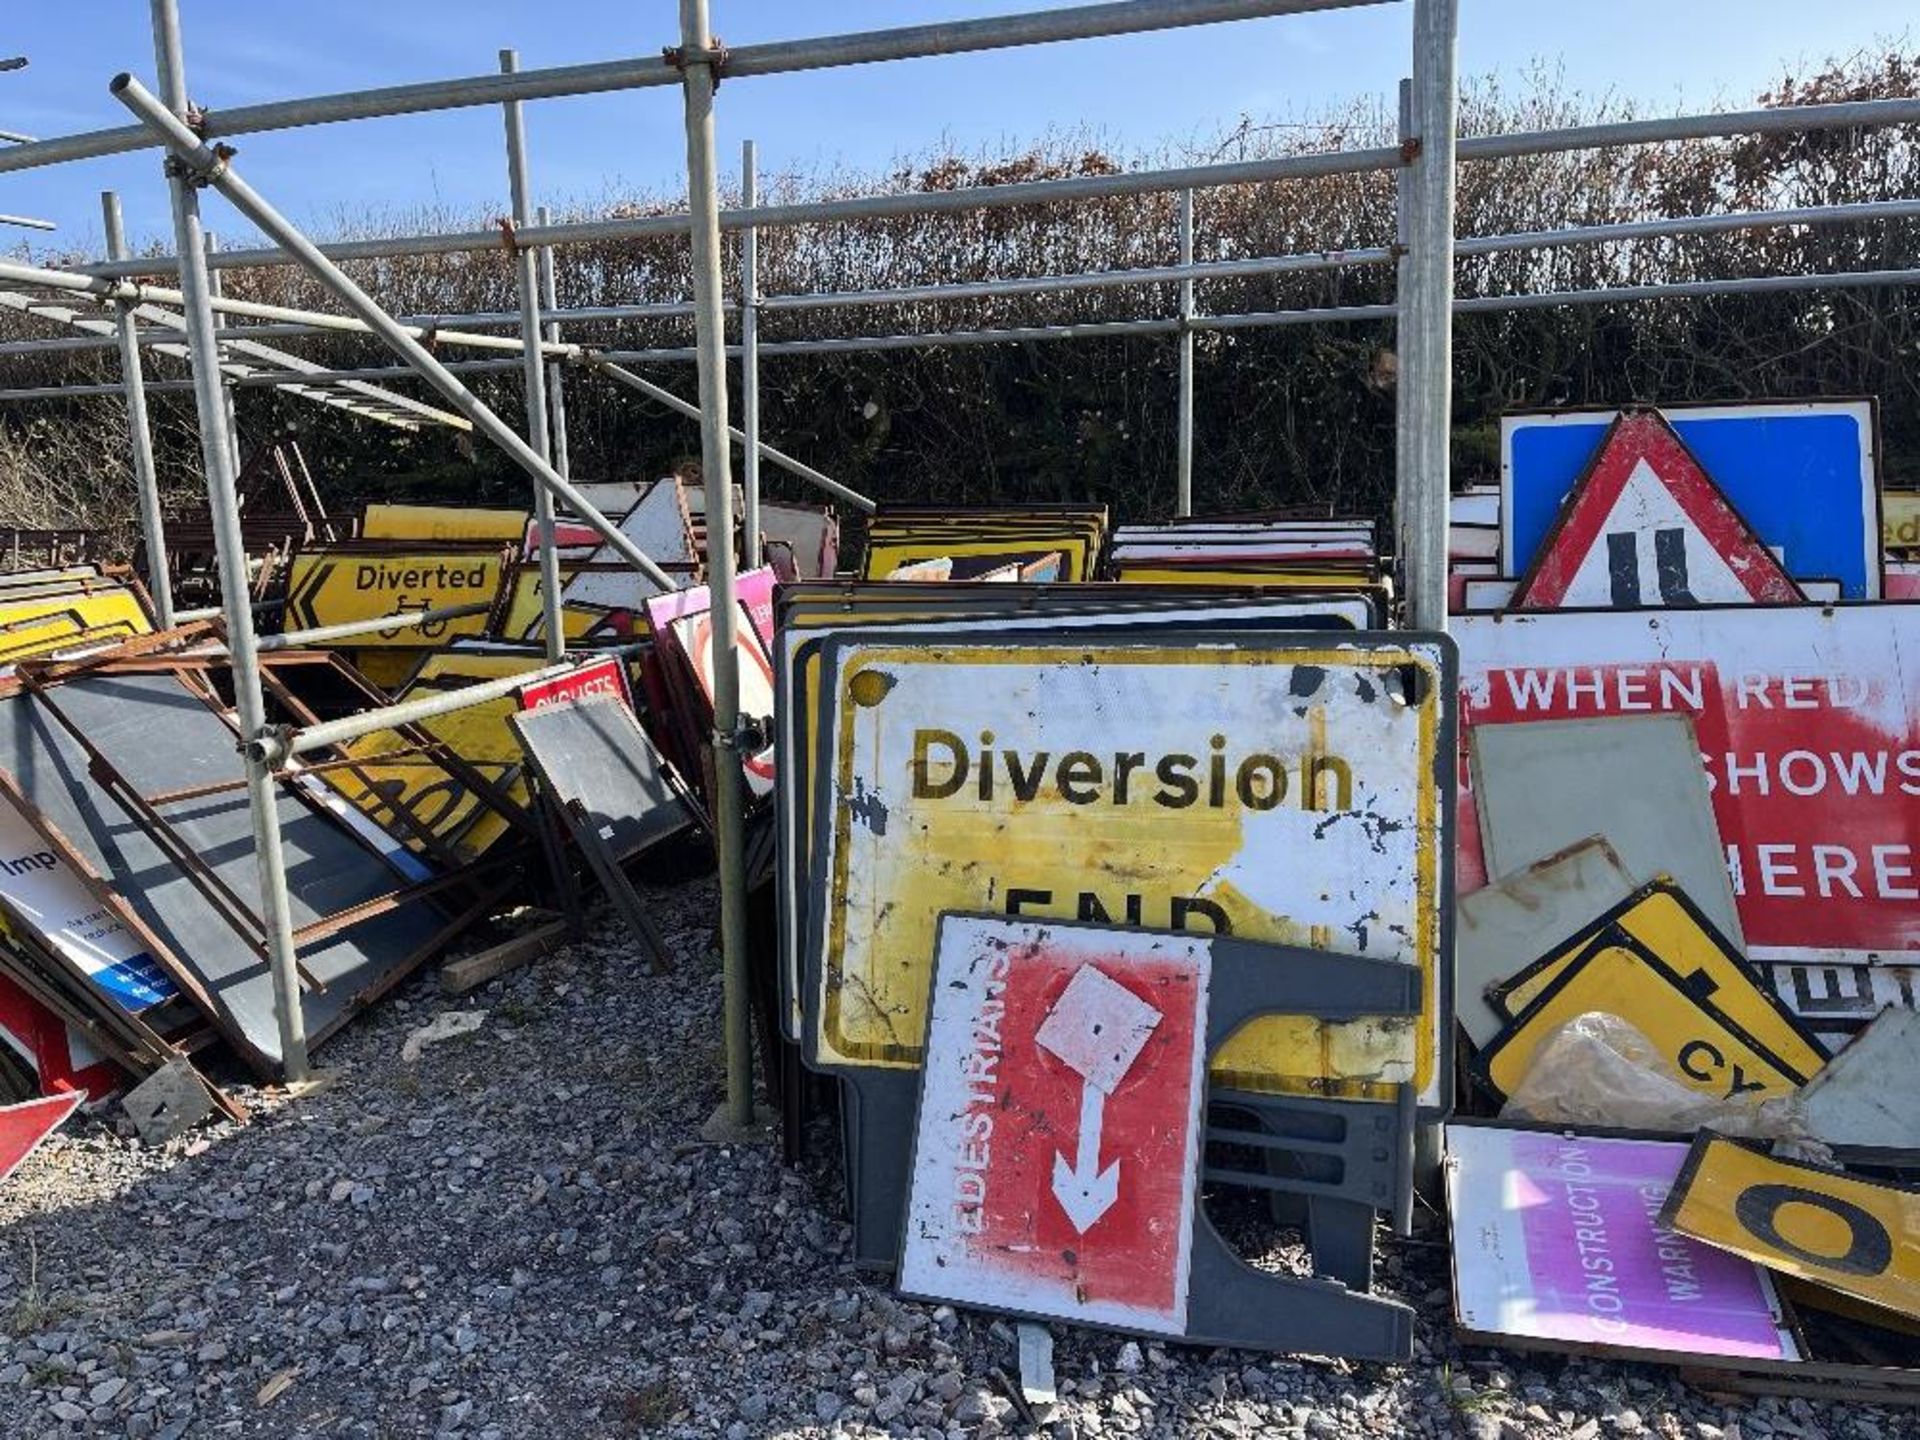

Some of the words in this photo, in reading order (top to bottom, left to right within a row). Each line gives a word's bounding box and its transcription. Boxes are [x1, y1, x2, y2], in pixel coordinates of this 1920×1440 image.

[356, 563, 486, 589] Diverted
[1505, 668, 1703, 710] WHEN
[1737, 670, 1868, 710] RED
[911, 728, 1353, 811] Diversion
[1558, 1146, 1628, 1334] CONSTRUCTION
